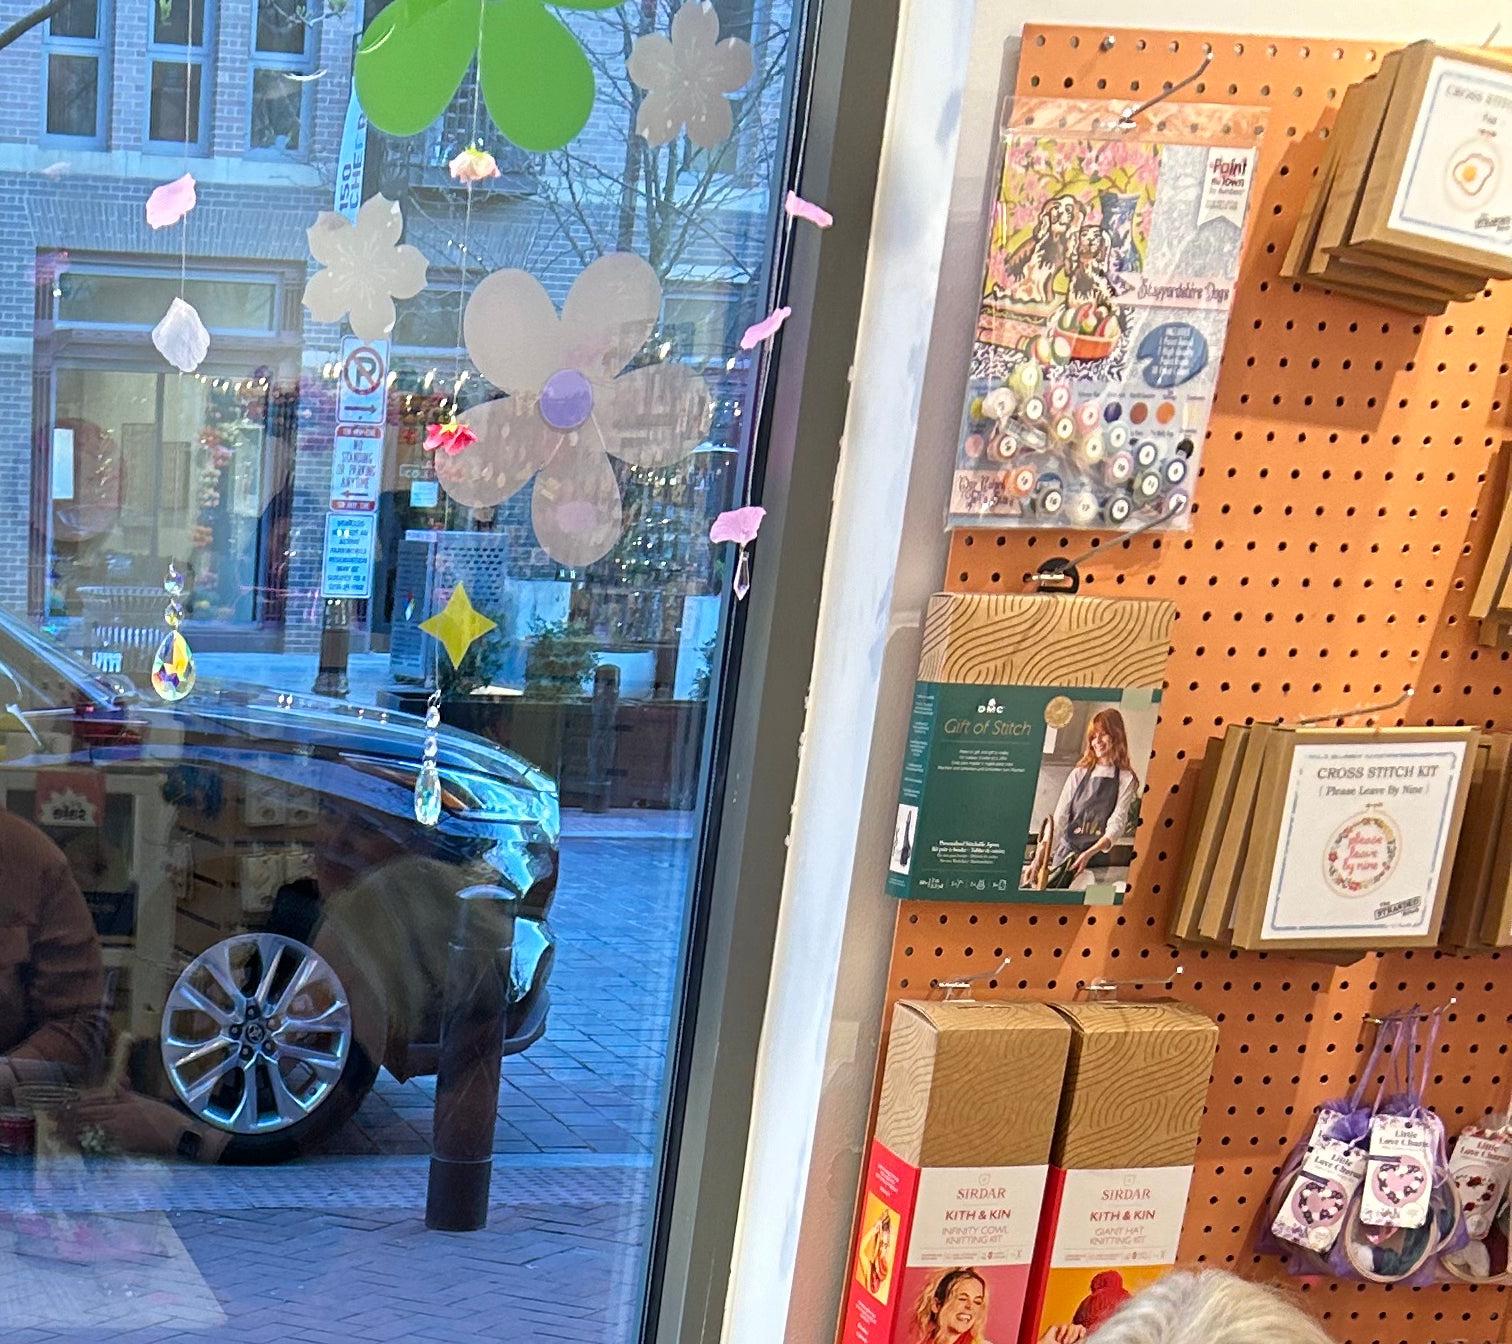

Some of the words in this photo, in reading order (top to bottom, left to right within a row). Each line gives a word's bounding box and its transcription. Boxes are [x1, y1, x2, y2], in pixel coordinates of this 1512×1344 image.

[1213, 156, 1247, 176] Paint
[339, 163, 352, 211] 150
[977, 704, 1004, 714] DMC
[944, 719, 970, 734] Gift
[972, 720, 990, 735] of
[991, 720, 1032, 736] Stitch
[1317, 766, 1364, 779] CROSS
[1367, 765, 1413, 778] STITCH
[1416, 764, 1439, 777] KIT
[1325, 785, 1356, 796] Please
[1358, 785, 1385, 796] Leave
[1387, 784, 1400, 796] By
[1402, 784, 1424, 794] Nine
[1395, 1130, 1418, 1139] Little
[1379, 1137, 1399, 1146] Love
[1314, 1156, 1334, 1169] Love
[1331, 1153, 1353, 1167] Little
[956, 1188, 1006, 1200] SIRDAR
[1101, 1188, 1151, 1200] SIRDAR
[945, 1210, 976, 1220] KITH
[978, 1210, 987, 1220] &
[989, 1209, 1011, 1219] KIN
[1090, 1211, 1120, 1222] KITH
[1122, 1210, 1131, 1220] &
[1134, 1210, 1156, 1220] KIN
[942, 1226, 978, 1236] INFINITY
[980, 1225, 1009, 1235] COWL
[1095, 1227, 1122, 1237] GIANT
[1125, 1226, 1145, 1235] HAT
[945, 1236, 988, 1245] KNITTING
[990, 1235, 1003, 1243] KIT
[1090, 1237, 1131, 1246] KNITTING
[1133, 1236, 1146, 1244] KIT
